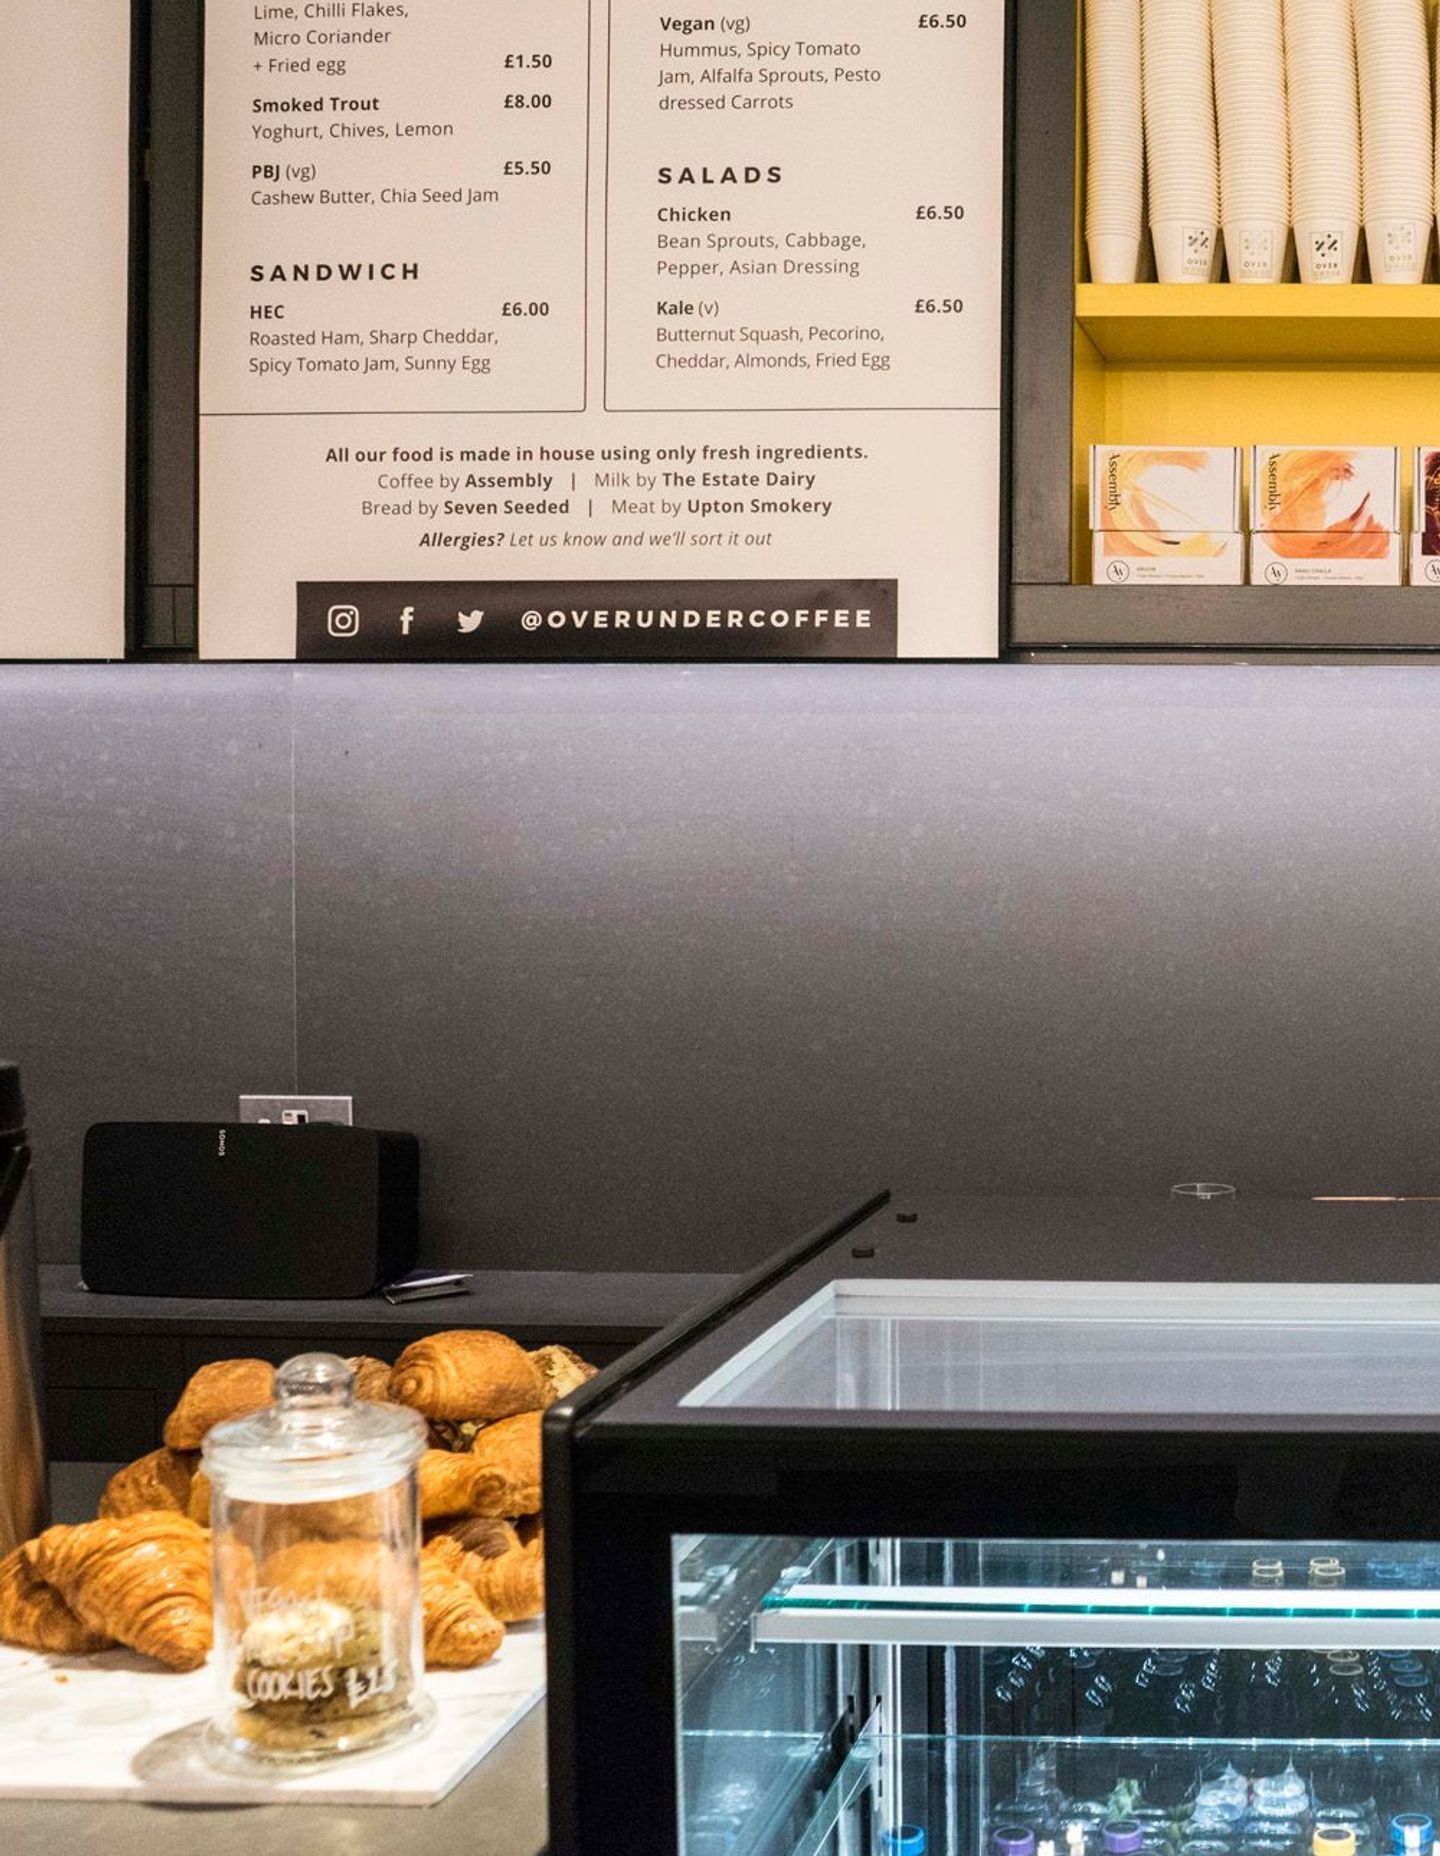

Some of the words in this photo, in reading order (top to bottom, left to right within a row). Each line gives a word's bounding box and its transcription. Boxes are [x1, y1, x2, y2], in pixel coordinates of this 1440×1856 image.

[253, 4, 299, 21] Lime,
[303, 2, 346, 19] Chilli
[351, 1, 409, 19] Flakes,
[917, 13, 967, 29] £6.50
[659, 16, 715, 36] Vegan
[720, 16, 751, 35] (vg)
[253, 30, 301, 47] Micro
[306, 27, 392, 45] Coriander
[503, 53, 553, 69] £1.50
[659, 42, 742, 59] Hummus,
[746, 41, 791, 61] Spicy
[794, 41, 862, 57] Tomato
[253, 60, 263, 72] +
[268, 57, 311, 74] Fried
[316, 59, 347, 77] egg
[656, 69, 695, 88] Jam,
[699, 67, 754, 84] Alfalfa
[758, 67, 829, 87] Sprouts,
[834, 67, 882, 83] Pesto
[252, 96, 324, 114] Smoked
[329, 96, 380, 112] Trout
[503, 93, 552, 109] £8.00
[658, 93, 726, 111] dressed
[730, 94, 794, 111] Carrots
[251, 123, 324, 144] Yoghurt,
[329, 122, 389, 140] Chives,
[395, 122, 454, 137] Lemon
[251, 164, 280, 183] PBJ
[285, 163, 317, 183] (vg)
[503, 160, 552, 176] £5.50
[657, 165, 782, 185] SALADS
[250, 189, 316, 206] Cashew
[319, 189, 376, 206] Butter,
[380, 187, 417, 204] Chia
[421, 187, 463, 203] Seed
[465, 187, 499, 206] Jam
[657, 206, 732, 223] Chicken
[915, 205, 965, 221] £6.50
[657, 233, 701, 249] Bean
[706, 232, 779, 253] Sprouts,
[784, 231, 866, 252] Cabbage,
[249, 262, 419, 283] SANDWICH
[656, 260, 724, 280] Pepper,
[728, 259, 778, 276] Asian
[783, 258, 860, 278] Dressing
[1315, 262, 1338, 270] OVER
[249, 304, 285, 320] HEC
[501, 301, 550, 317] £6.00
[656, 299, 695, 316] Kale
[698, 300, 720, 318] (v)
[914, 298, 964, 314] £6.50
[249, 329, 316, 347] Roasted
[320, 330, 365, 347] Ham,
[369, 329, 418, 349] Sharp
[422, 327, 499, 346] Cheddar,
[656, 326, 736, 343] Butternut
[739, 325, 804, 346] Squash,
[808, 325, 885, 342] Pecorino,
[248, 356, 293, 377] Spicy
[295, 356, 360, 373] Tomato
[361, 356, 399, 375] Jam,
[404, 355, 457, 375] Sunny
[461, 354, 491, 375] Egg
[655, 352, 730, 371] Cheddar,
[733, 352, 811, 370] Almonds,
[816, 351, 857, 368] Fried
[861, 352, 891, 372] Egg
[325, 446, 350, 463] All
[354, 450, 388, 463] our
[391, 446, 434, 463] food
[439, 446, 454, 462] is
[459, 445, 511, 462] made
[516, 445, 534, 462] in
[539, 445, 595, 462] house
[600, 445, 651, 465] using
[656, 444, 697, 465] only
[702, 444, 750, 461] fresh
[756, 444, 868, 465] ingredients.
[377, 472, 434, 490] Coffee
[439, 473, 460, 493] by
[464, 472, 553, 492] Assembly
[594, 471, 631, 488] Milk
[636, 472, 657, 492] by
[661, 471, 696, 487] The
[702, 472, 760, 487] Estate
[766, 470, 816, 491] Dairy
[1104, 453, 1122, 511] Assembly
[1264, 453, 1282, 511] Assembly
[361, 499, 412, 516] Bread
[418, 499, 439, 520] by
[443, 500, 498, 516] Seven
[503, 498, 570, 515] Seeded
[611, 499, 656, 515] Meat
[661, 498, 682, 518] by
[687, 498, 745, 518] Upton
[750, 497, 833, 518] Smokery
[418, 531, 506, 552] Allergies?
[509, 531, 534, 548] Let
[538, 534, 558, 547] us
[562, 531, 608, 547] know
[611, 531, 645, 547] and
[649, 530, 686, 547] we'll
[690, 533, 723, 547] sort
[728, 533, 739, 546] it
[744, 532, 773, 546] out
[520, 609, 872, 632] @OVERUNDERCOFFEE
[218, 1129, 226, 1156] SONOS
[247, 1665, 335, 1702] COOKIES
